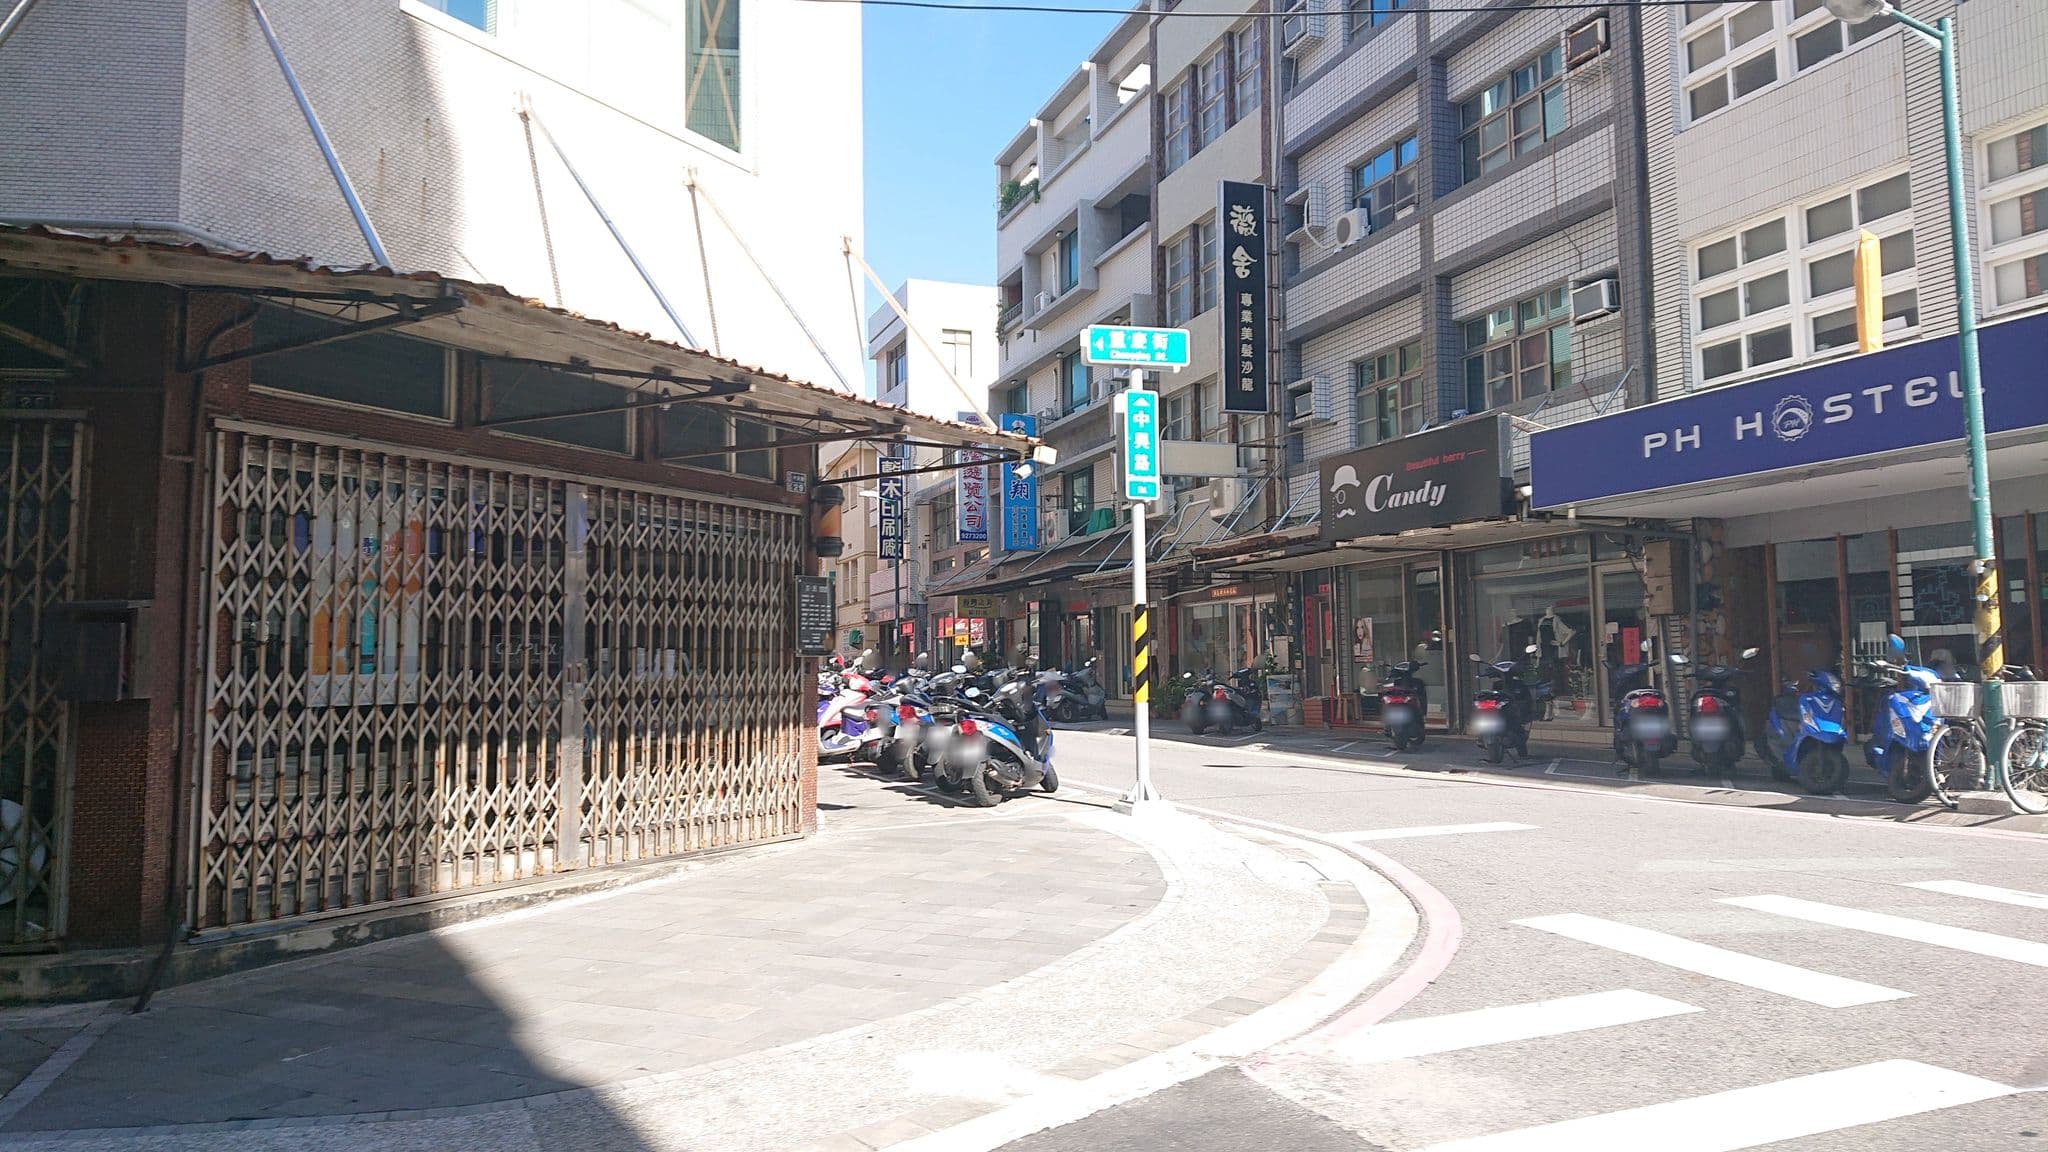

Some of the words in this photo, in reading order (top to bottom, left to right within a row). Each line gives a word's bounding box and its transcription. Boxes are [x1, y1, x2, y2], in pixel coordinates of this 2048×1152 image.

[1240, 292, 1254, 392] 專業美髮沙龍
[1132, 410, 1151, 471] 中興路
[1643, 424, 1701, 458] PH
[1364, 472, 1447, 513] Candy
